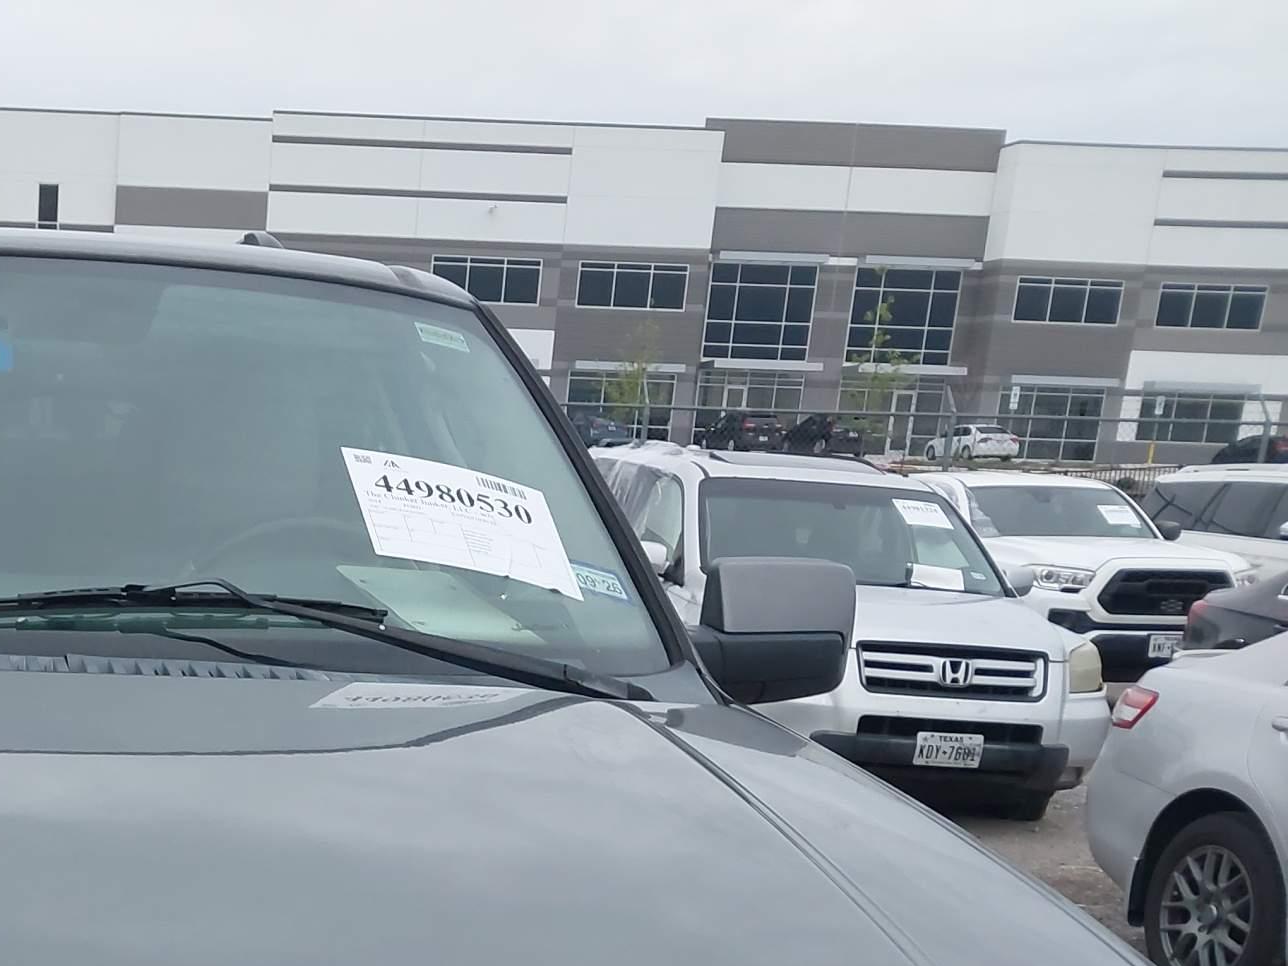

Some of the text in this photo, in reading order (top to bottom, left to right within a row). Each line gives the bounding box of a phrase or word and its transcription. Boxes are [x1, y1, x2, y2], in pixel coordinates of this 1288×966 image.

[374, 474, 532, 525] 44980530
[576, 572, 597, 588] 09
[939, 735, 964, 744] TEXAS
